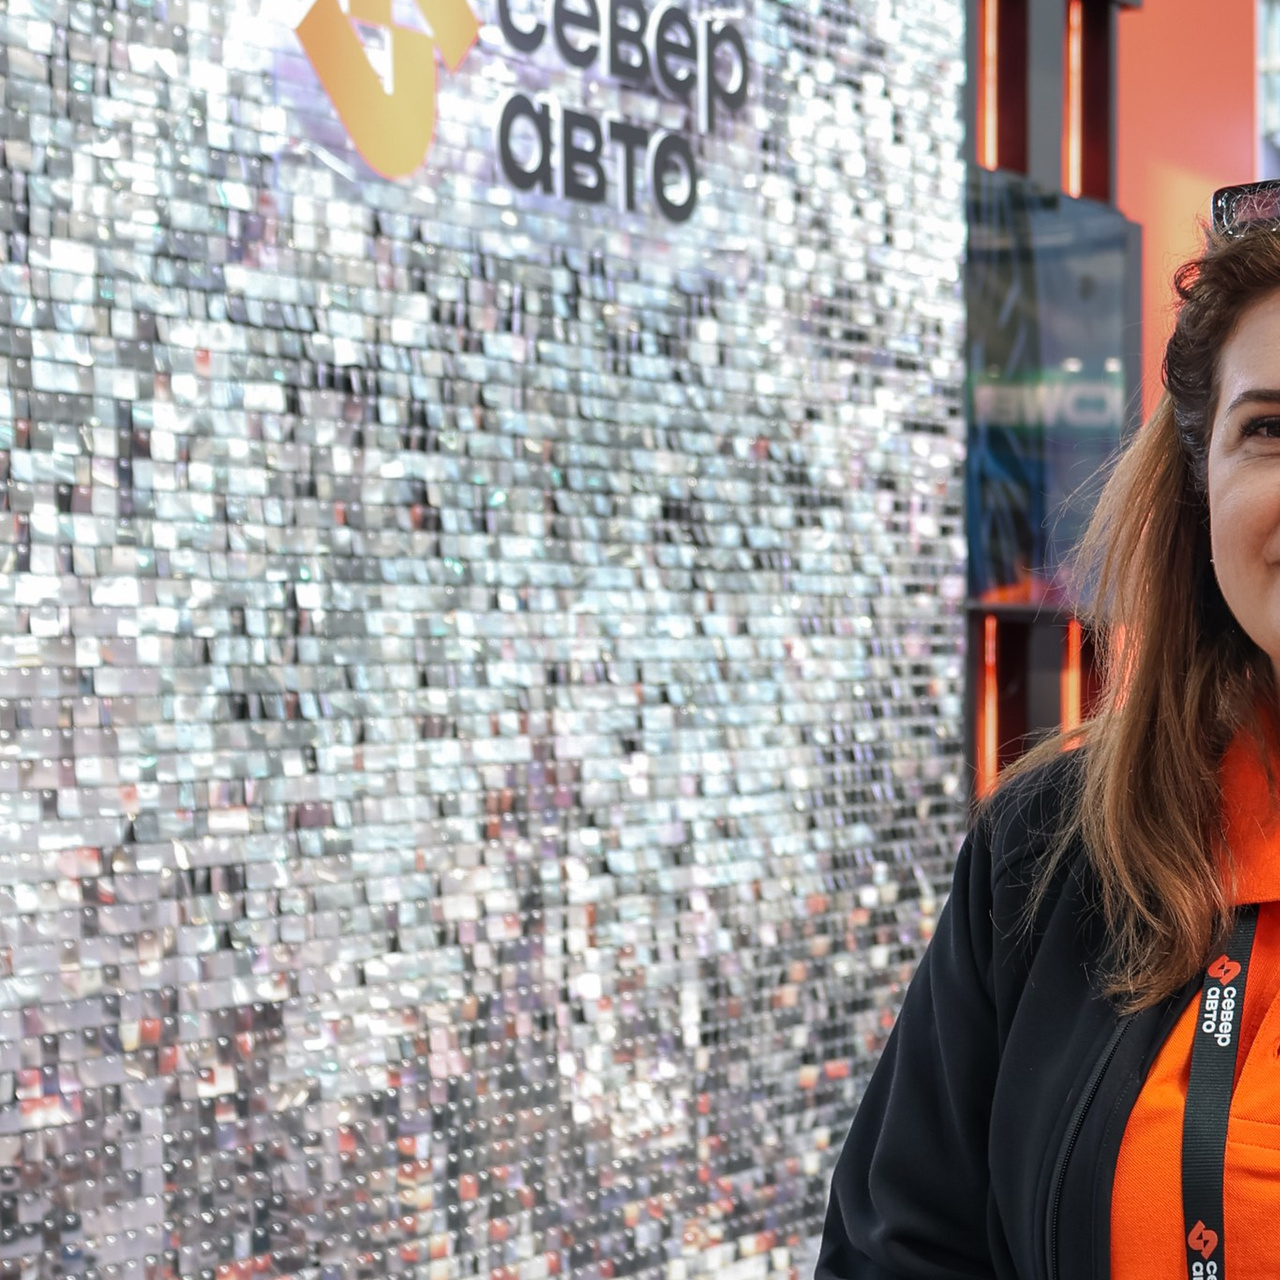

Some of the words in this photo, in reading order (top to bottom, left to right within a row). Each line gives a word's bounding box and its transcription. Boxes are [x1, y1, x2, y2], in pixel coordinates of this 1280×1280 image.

[498, 93, 698, 225] авто
[1202, 986, 1221, 1034] авто
[1214, 986, 1237, 1047] север
